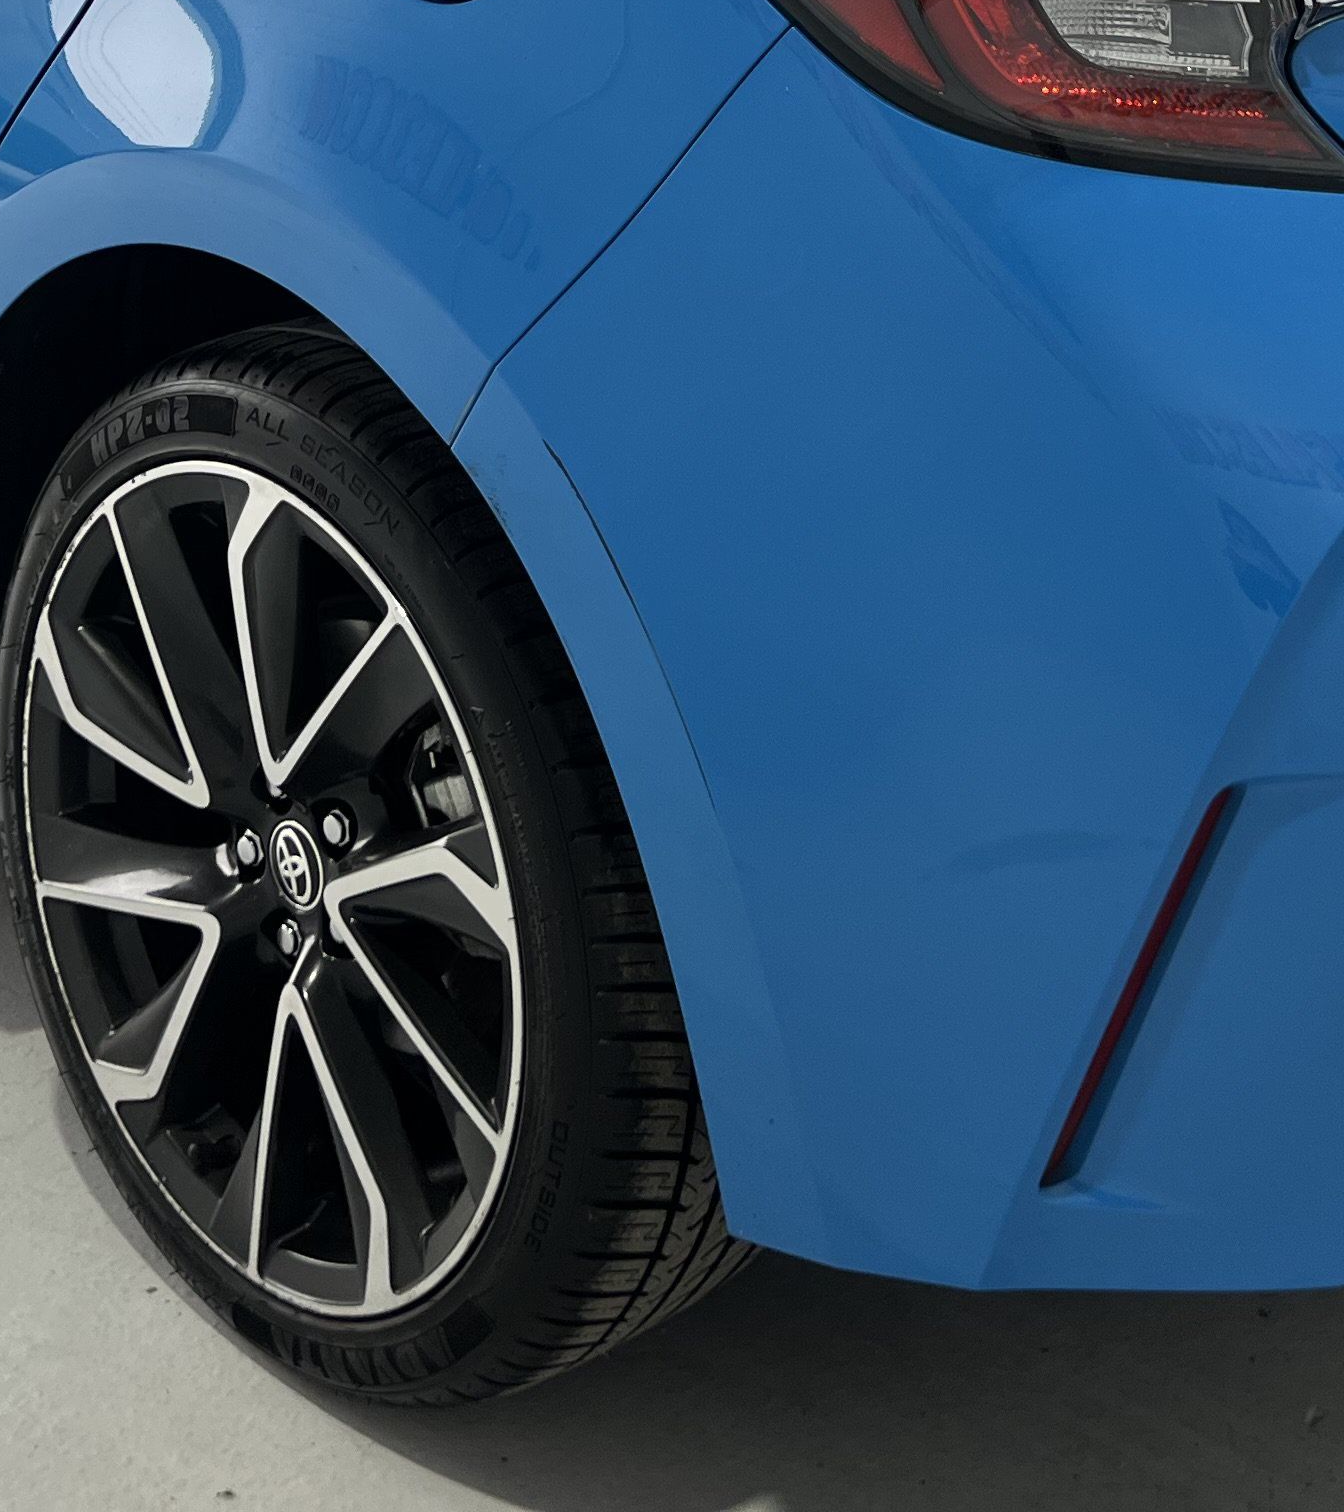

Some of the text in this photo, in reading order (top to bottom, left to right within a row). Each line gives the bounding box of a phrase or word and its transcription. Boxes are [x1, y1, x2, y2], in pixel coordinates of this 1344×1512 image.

[90, 395, 191, 468] HPZ-02
[246, 407, 291, 442] ALL
[299, 433, 401, 537] SEASON
[523, 1120, 570, 1253] OUTSIDE
